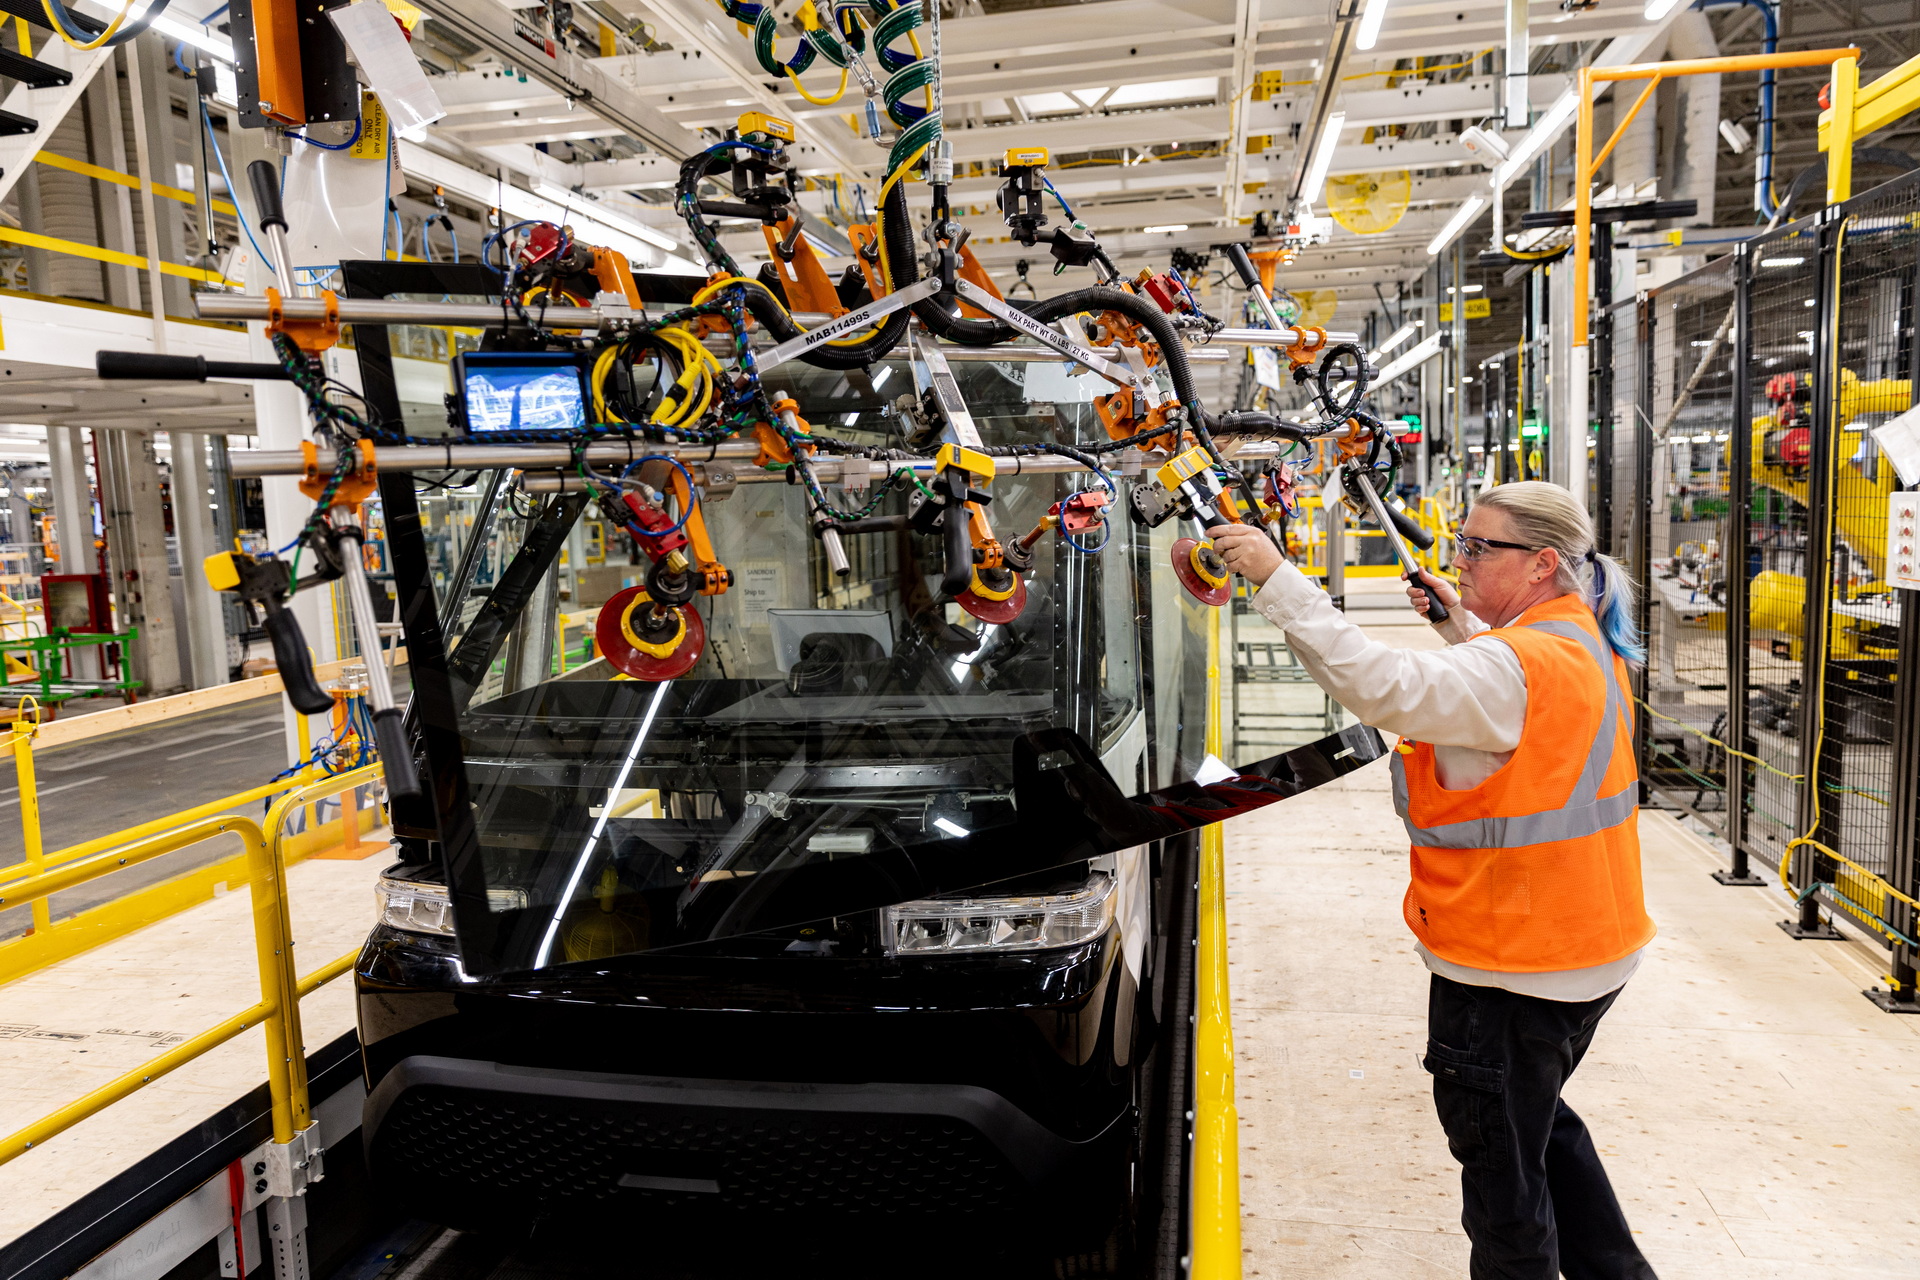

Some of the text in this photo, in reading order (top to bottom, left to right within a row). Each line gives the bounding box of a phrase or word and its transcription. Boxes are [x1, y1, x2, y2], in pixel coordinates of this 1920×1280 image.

[516, 21, 544, 47] KNIGHT
[805, 311, 870, 345] MAB11499S
[1008, 310, 1022, 324] MAX
[1022, 318, 1039, 332] PART
[1037, 327, 1050, 338] WT
[1049, 333, 1057, 343] 60
[1057, 338, 1070, 350] LBS
[1072, 346, 1080, 356] 27
[1080, 352, 1090, 361] KG
